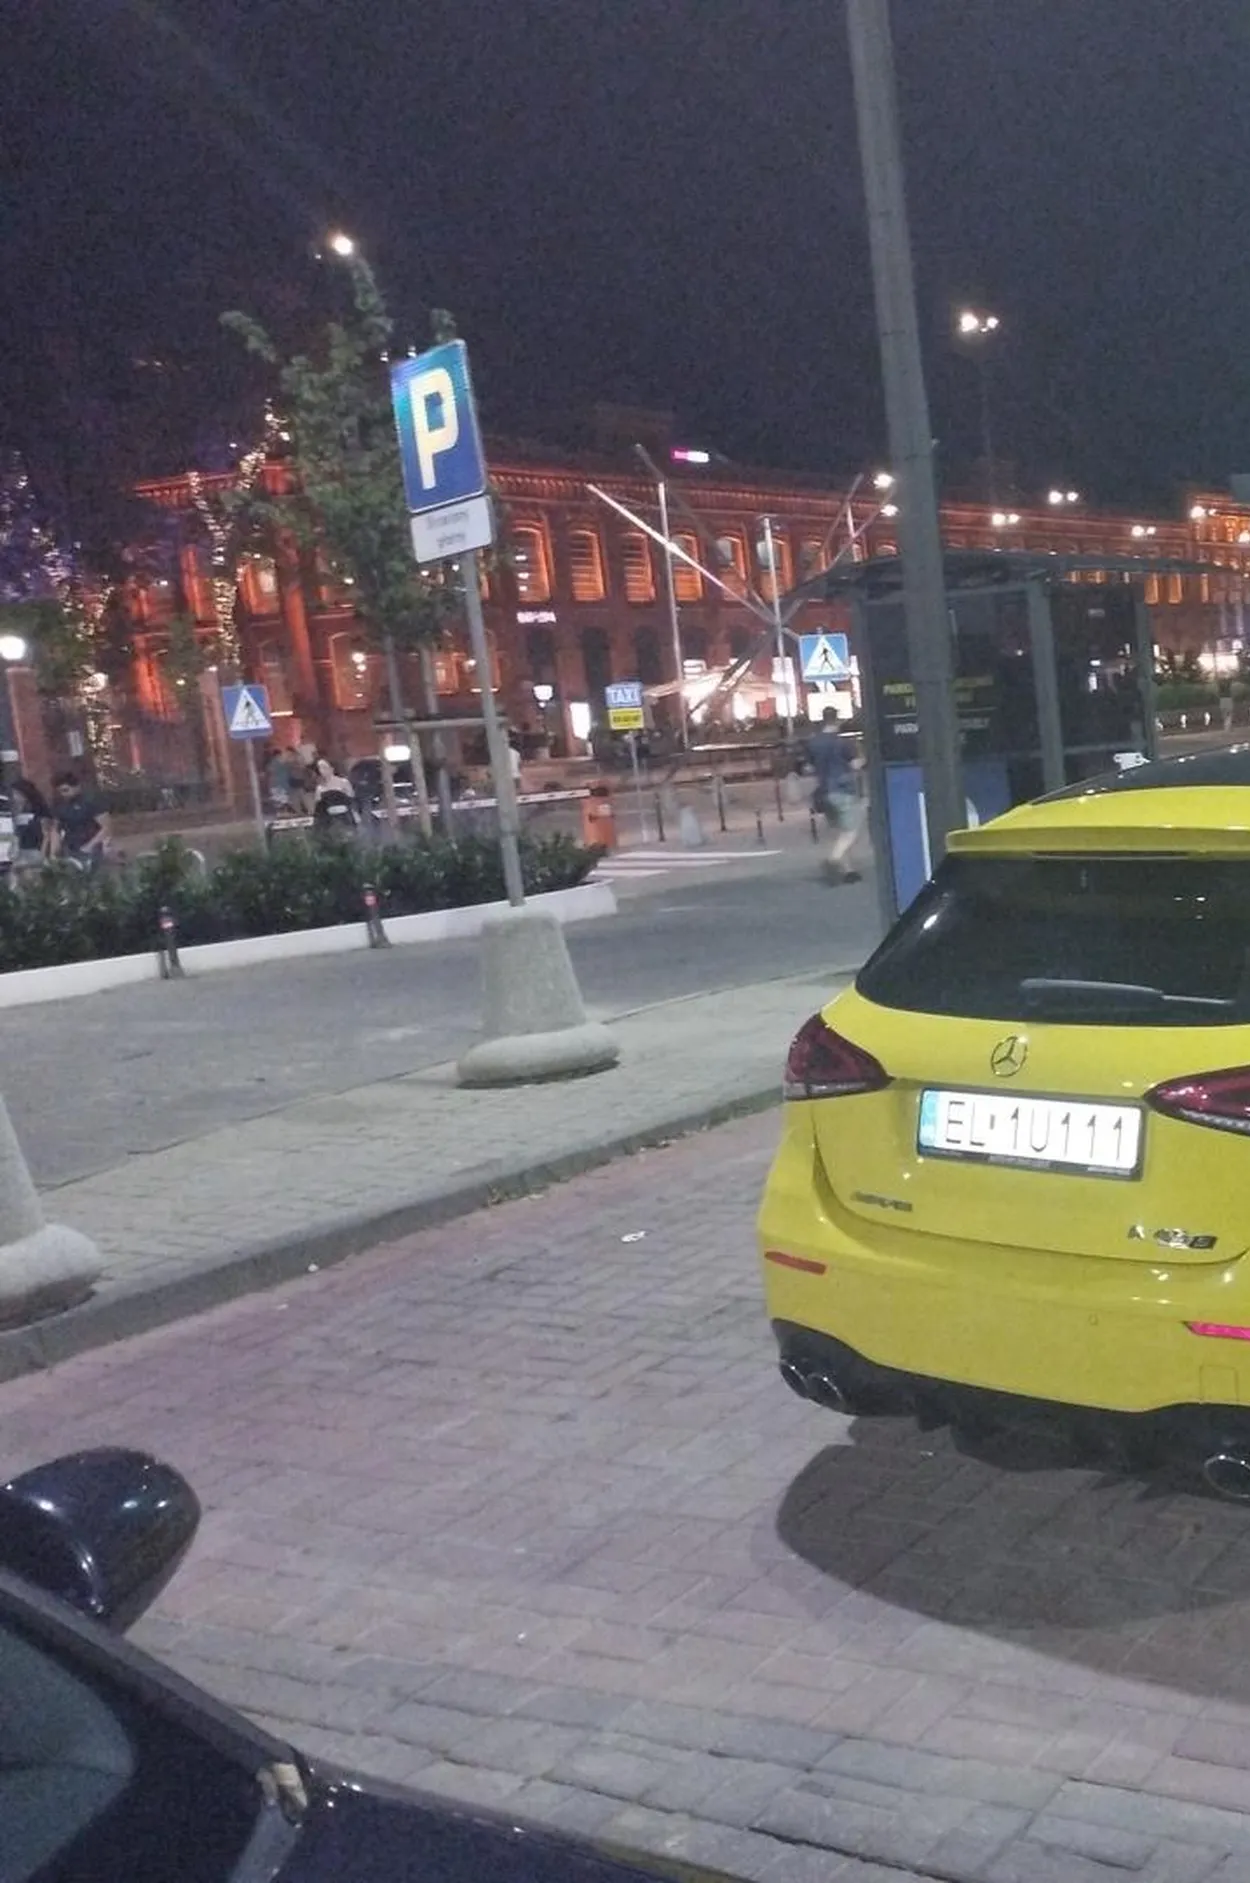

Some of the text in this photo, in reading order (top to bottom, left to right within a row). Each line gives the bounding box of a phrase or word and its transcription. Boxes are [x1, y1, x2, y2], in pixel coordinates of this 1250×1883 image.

[409, 367, 459, 490] P
[609, 687, 641, 704] TAXI
[945, 1100, 1125, 1163] EL 1U111
